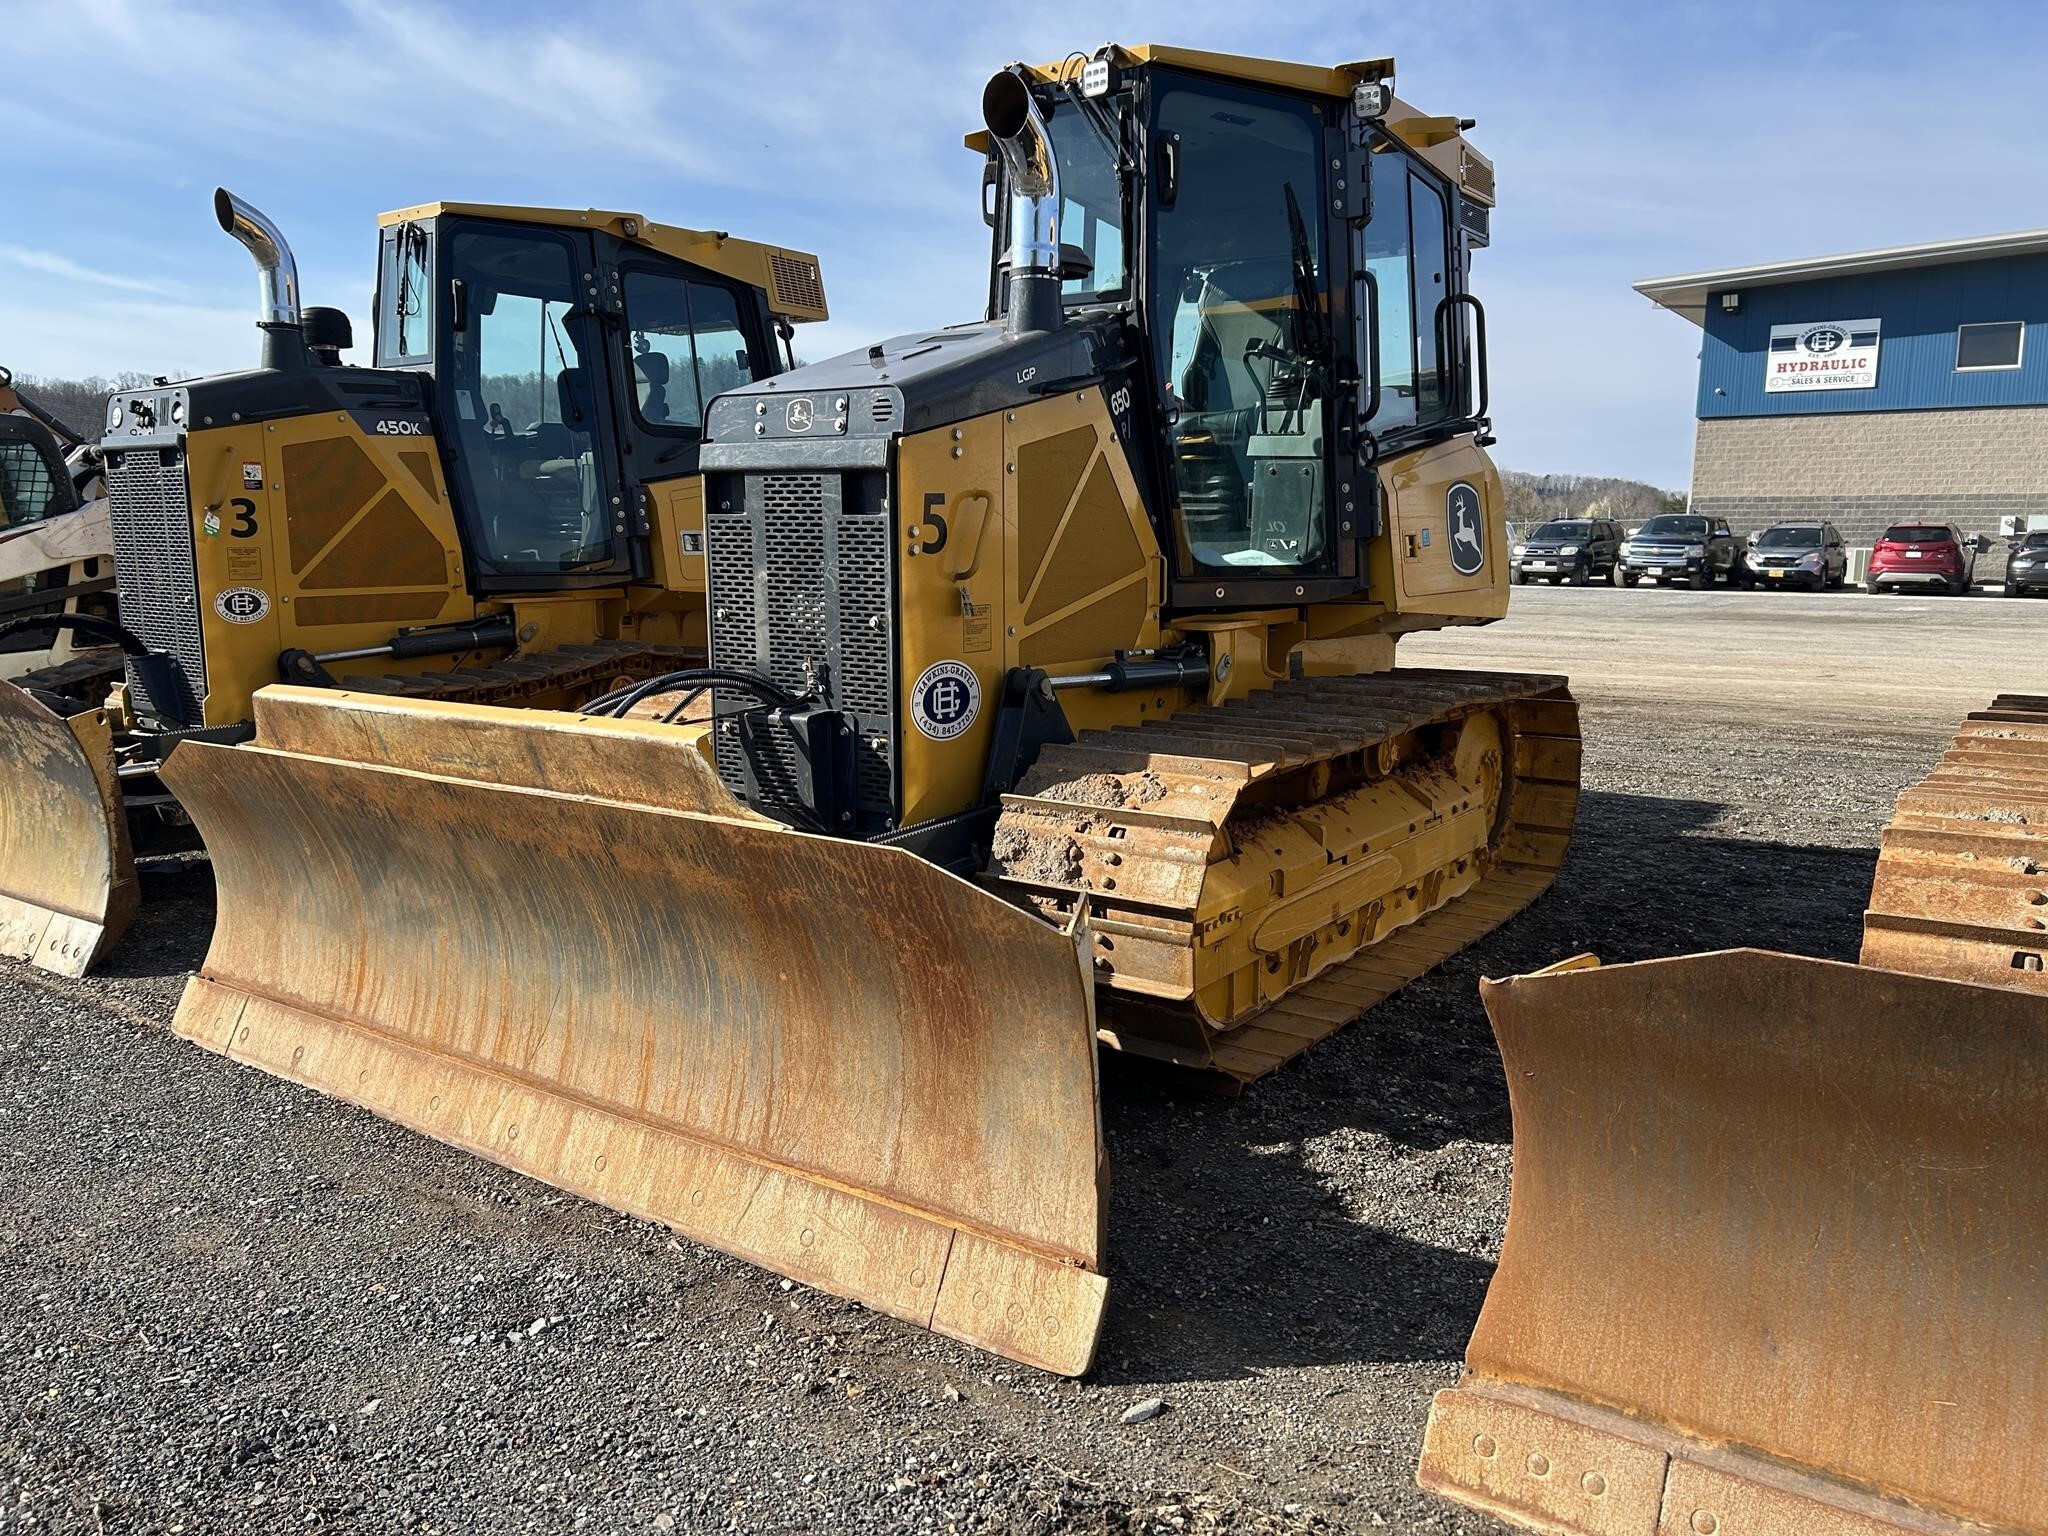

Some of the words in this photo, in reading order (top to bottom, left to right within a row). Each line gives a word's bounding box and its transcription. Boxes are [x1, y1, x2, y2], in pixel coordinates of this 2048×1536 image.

[1016, 367, 1036, 384] LGP
[1777, 358, 1867, 373] HYDRAULIC
[1791, 376, 1813, 385] SALES
[1816, 376, 1821, 384] &
[1824, 375, 1856, 384] SERVICE
[1111, 386, 1130, 416] 650
[376, 420, 422, 435] 450K
[230, 497, 258, 538] 3
[922, 492, 948, 554] 5
[918, 665, 975, 695] HAWKINS-GRAVES
[919, 716, 940, 735] (434)
[942, 709, 974, 735] 847-7703
